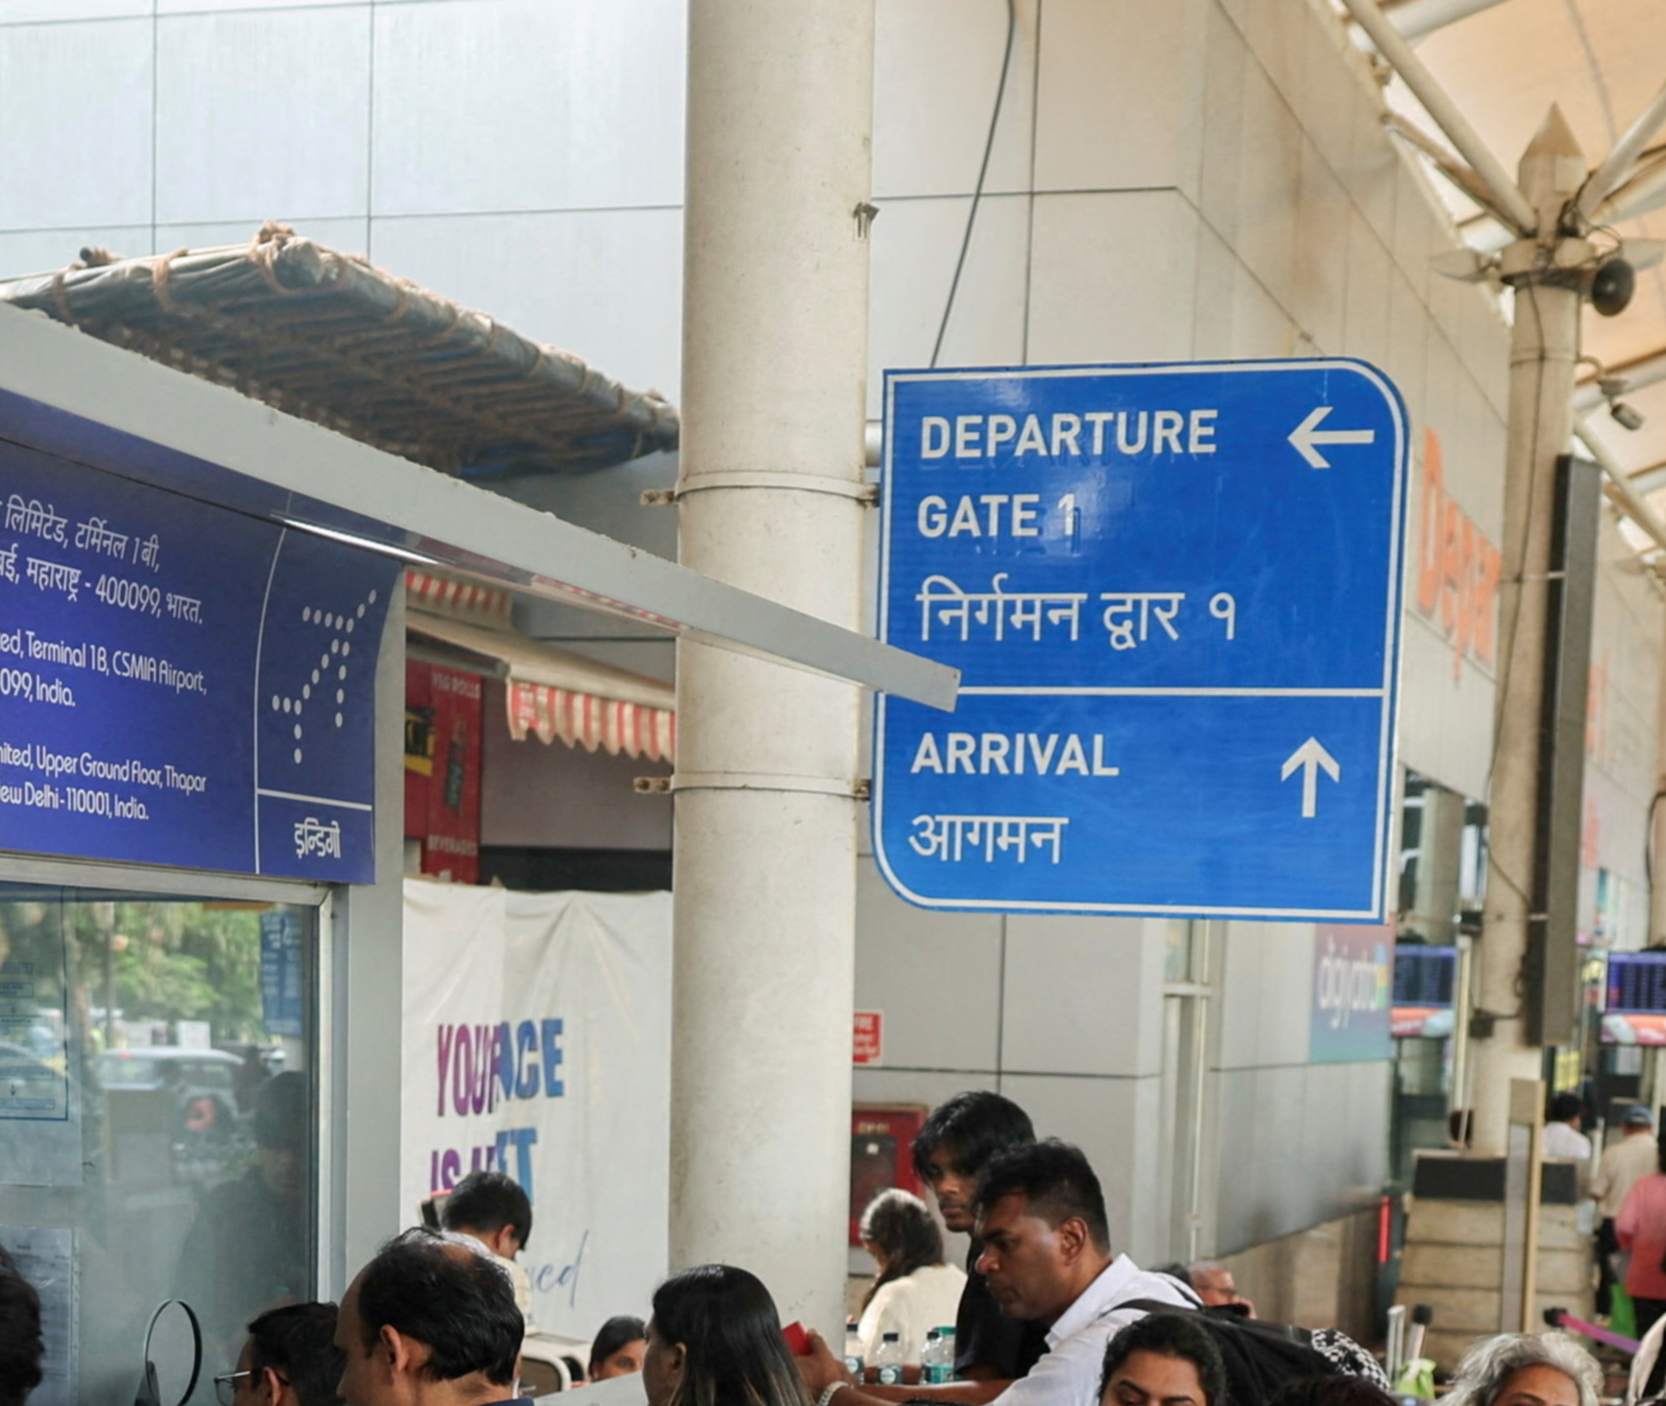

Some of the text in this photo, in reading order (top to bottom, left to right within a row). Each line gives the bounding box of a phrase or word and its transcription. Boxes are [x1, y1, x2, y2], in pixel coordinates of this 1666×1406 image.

[920, 409, 1219, 460] DEPARTURE
[5, 494, 69, 549] लिमिटेड,
[75, 516, 128, 560] टर्मिनल
[916, 492, 1078, 538] GATE 1
[26, 555, 81, 601] महाराष्ट्र
[95, 576, 162, 618] 400099,
[166, 593, 203, 625] भारत.
[916, 573, 1088, 641] निर्गमन
[1100, 592, 1186, 650] द्वार
[26, 631, 86, 668] Terminal
[90, 645, 110, 676] 1B,
[113, 650, 157, 682] CSMIA
[158, 659, 207, 696] Airport,
[36, 674, 76, 707] India.
[36, 745, 78, 778] Upper
[80, 752, 130, 782] Ground
[131, 759, 163, 789] Floor,
[165, 765, 207, 796] Thapar
[910, 733, 1119, 777] ARRIVAL
[114, 796, 149, 820] India.
[908, 815, 1069, 864] आगमन
